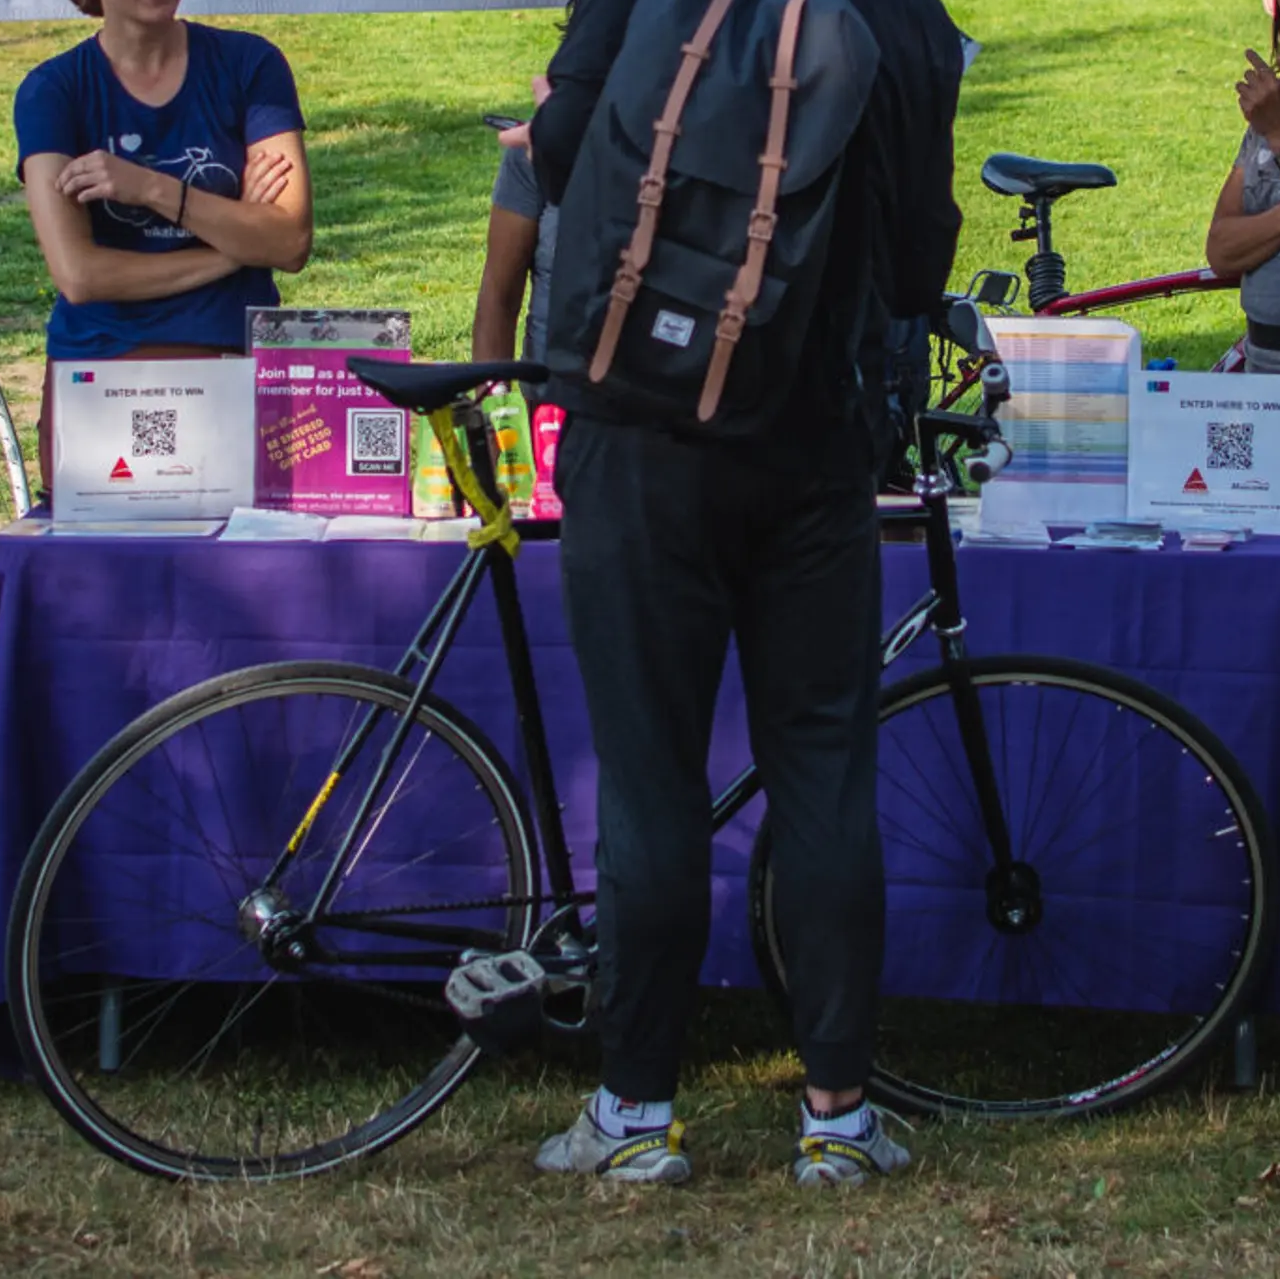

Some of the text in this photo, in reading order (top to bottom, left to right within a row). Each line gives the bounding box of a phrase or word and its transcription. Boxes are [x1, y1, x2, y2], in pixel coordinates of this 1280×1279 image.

[257, 366, 286, 379] Join
[317, 370, 334, 379] as
[336, 370, 345, 379] a
[105, 388, 204, 398] ENTER HERE TO WIN
[257, 384, 313, 396] member
[315, 384, 335, 396] for
[337, 385, 362, 398] just
[1180, 400, 1213, 409] ENTER
[1216, 401, 1243, 410] HERE
[1246, 401, 1259, 410] TO
